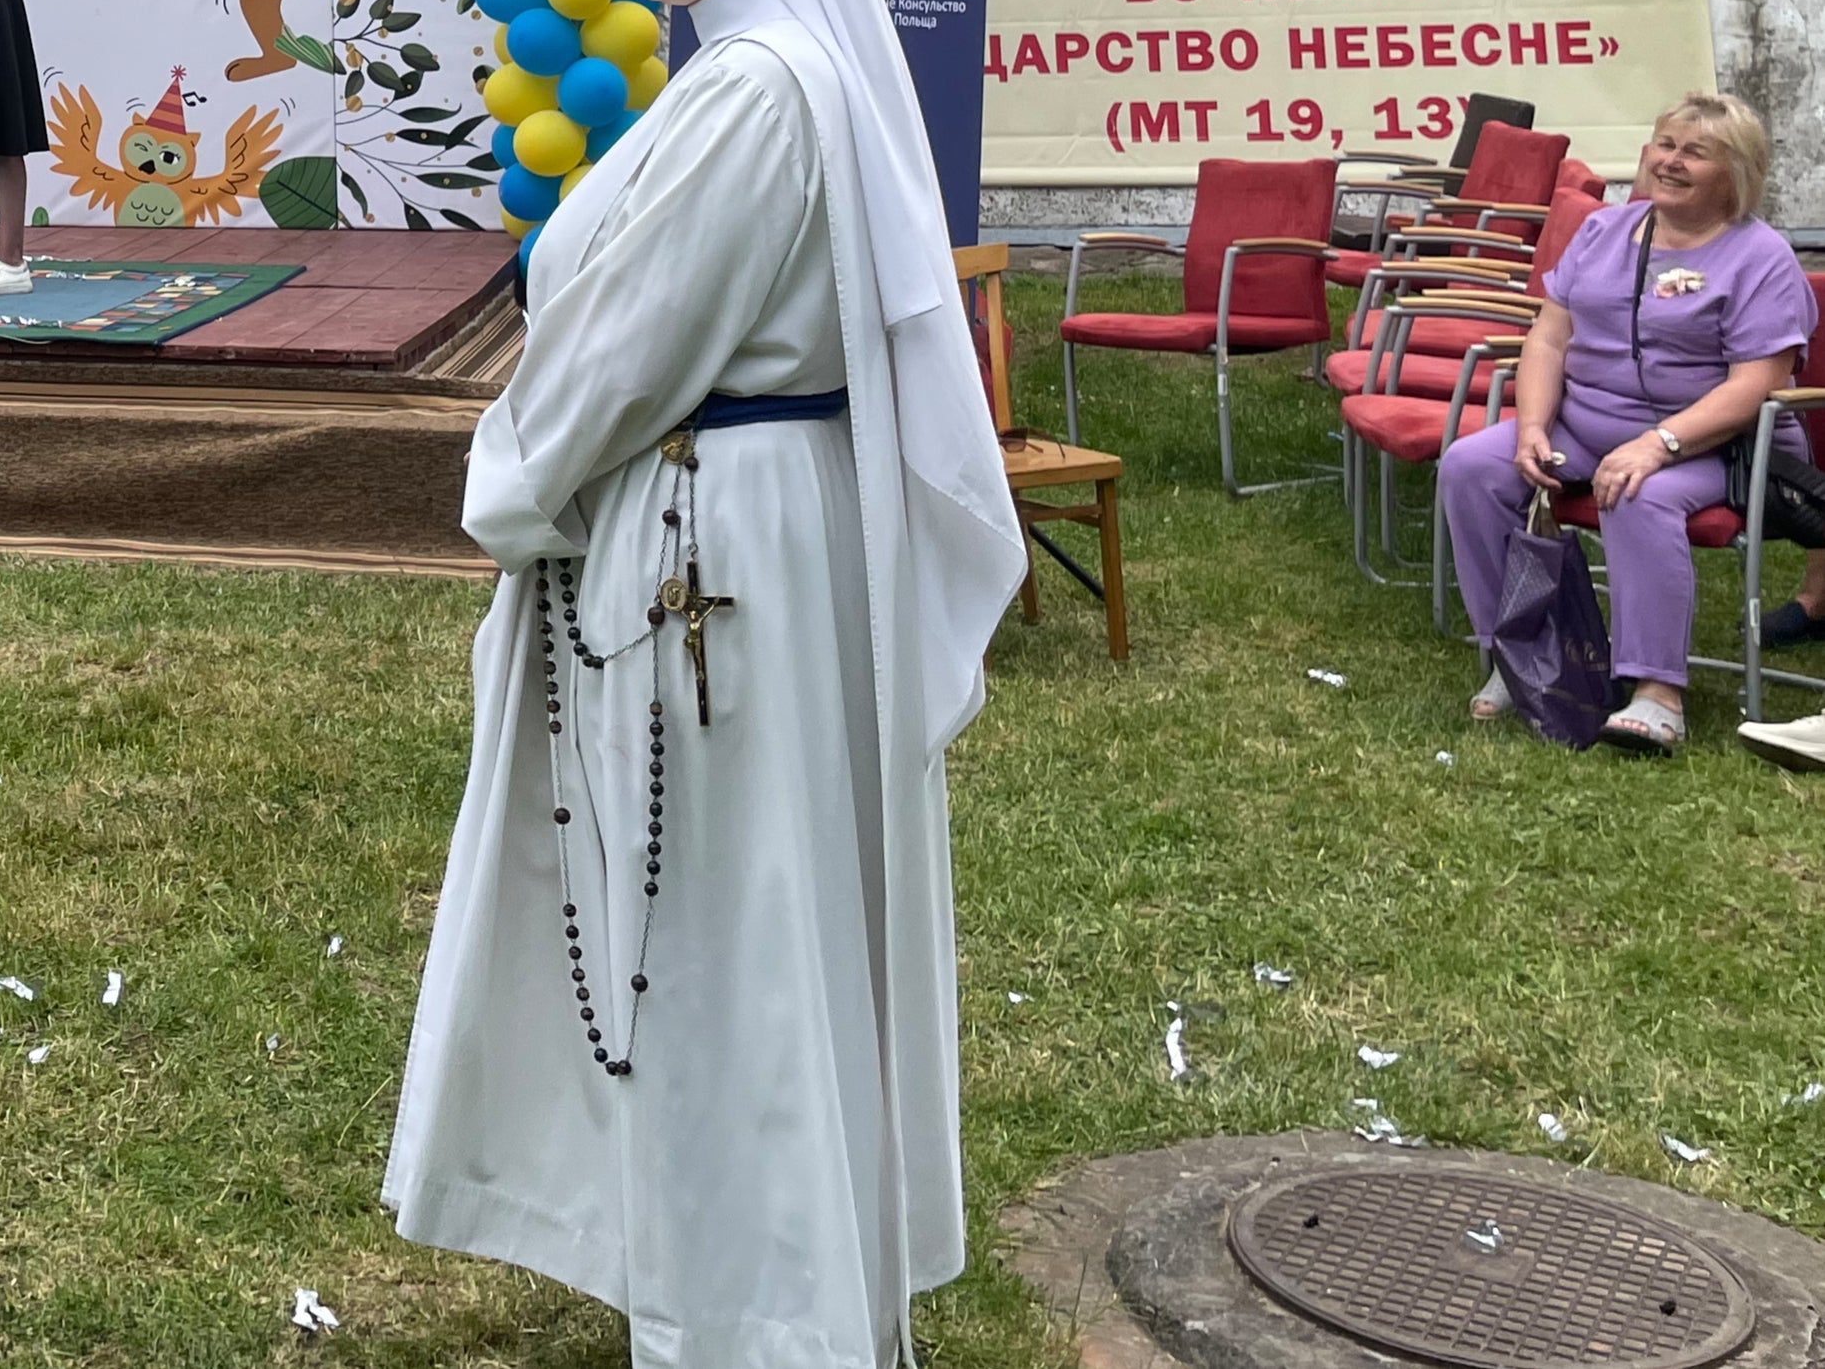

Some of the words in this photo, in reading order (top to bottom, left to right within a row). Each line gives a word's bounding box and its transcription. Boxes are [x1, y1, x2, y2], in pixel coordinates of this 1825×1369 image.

[894, 12, 937, 29] Польща
[1288, 21, 1620, 70] НЕБЕСНЕ»
[1106, 101, 1219, 152] (МТ
[1246, 98, 1344, 150] 19,
